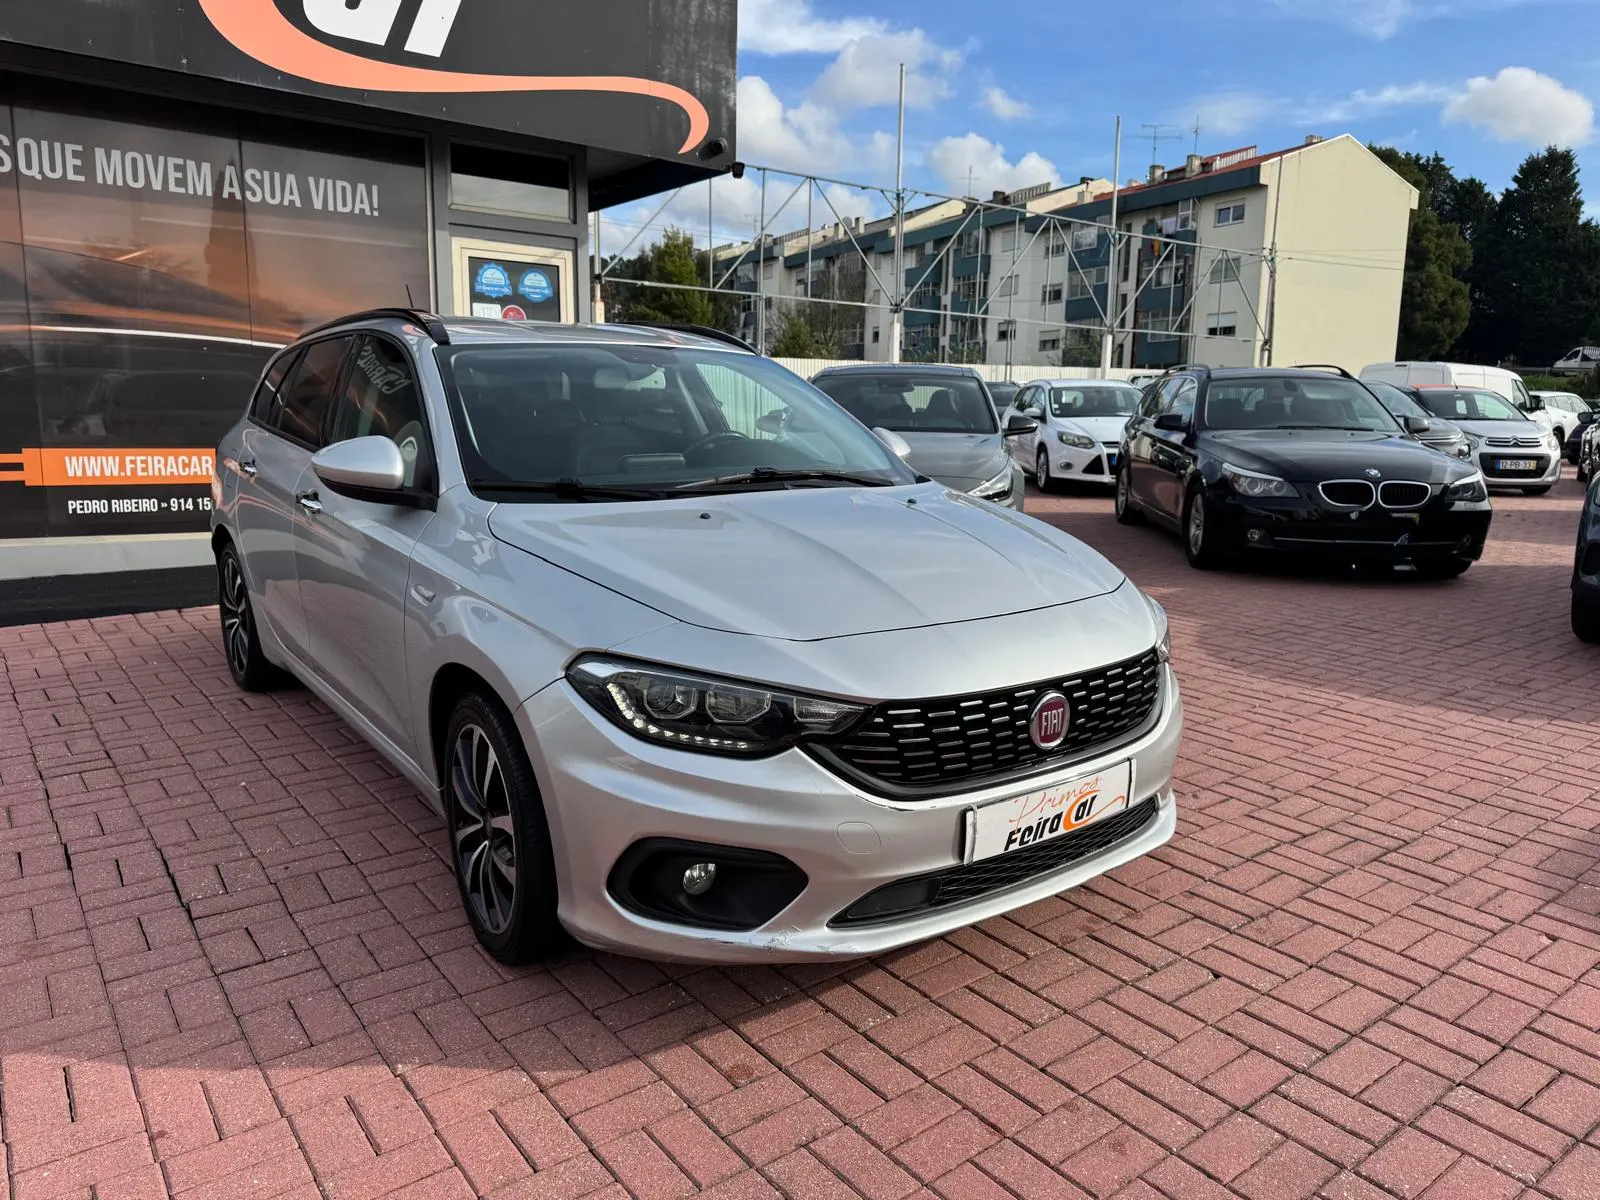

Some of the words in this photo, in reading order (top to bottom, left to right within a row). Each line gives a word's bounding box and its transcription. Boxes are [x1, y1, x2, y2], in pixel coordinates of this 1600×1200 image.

[16, 137, 86, 182] QUE
[94, 147, 213, 197] MOVEM
[222, 165, 242, 200] A
[245, 168, 302, 208] SUA
[308, 176, 379, 217] VIDA!
[64, 455, 213, 477] WWW.FEIRACAR
[68, 500, 109, 514] PEDRO
[112, 498, 158, 513] RIBEIRO
[171, 498, 194, 512] 914
[1041, 708, 1064, 737] FIAT
